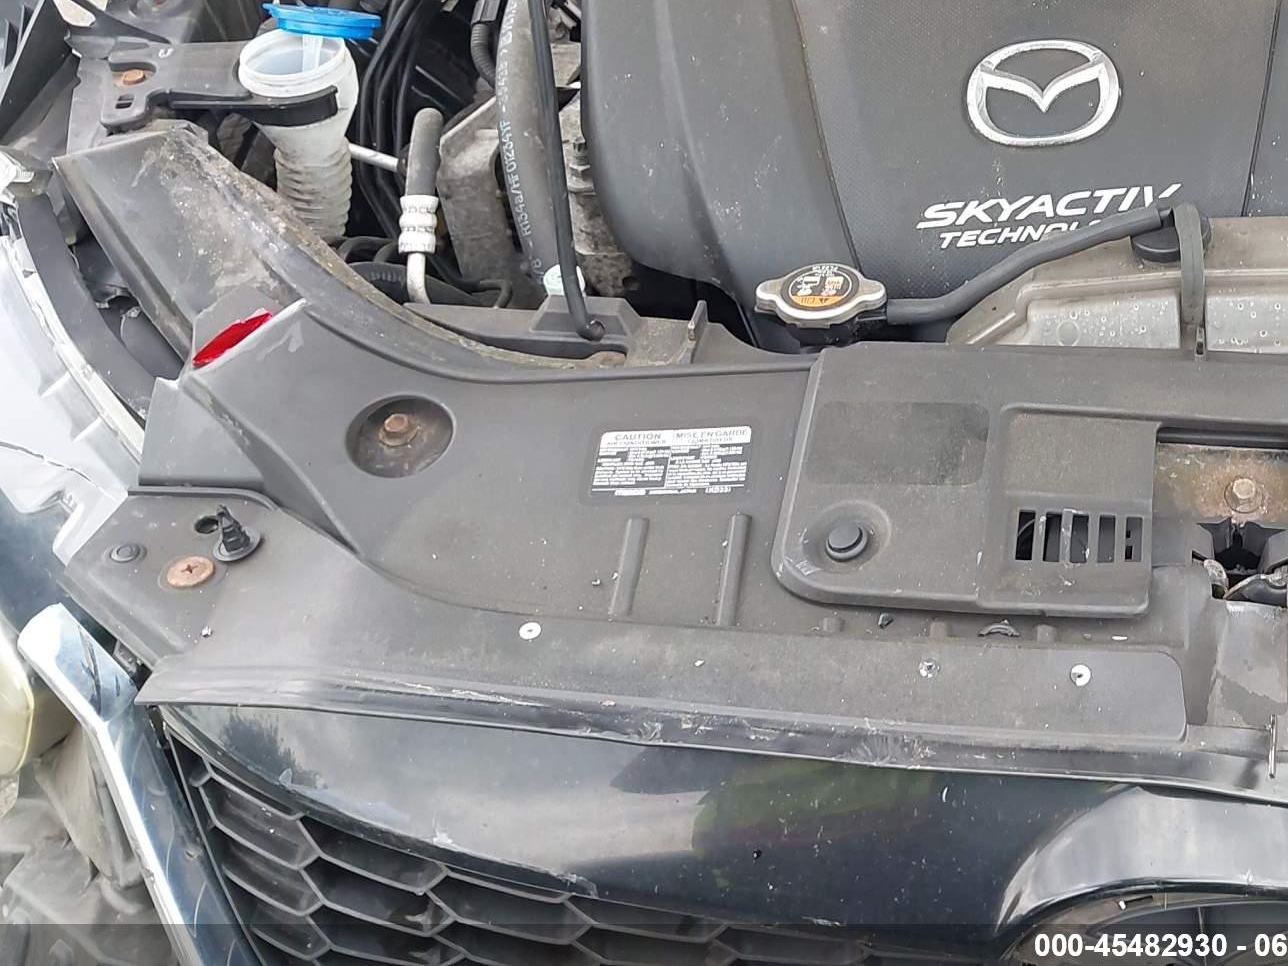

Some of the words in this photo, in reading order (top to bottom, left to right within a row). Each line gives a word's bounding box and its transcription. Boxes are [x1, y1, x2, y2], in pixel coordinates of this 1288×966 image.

[916, 183, 1182, 229] SKYACTIV
[615, 432, 662, 441] CAUTION
[716, 428, 748, 437] GARDE
